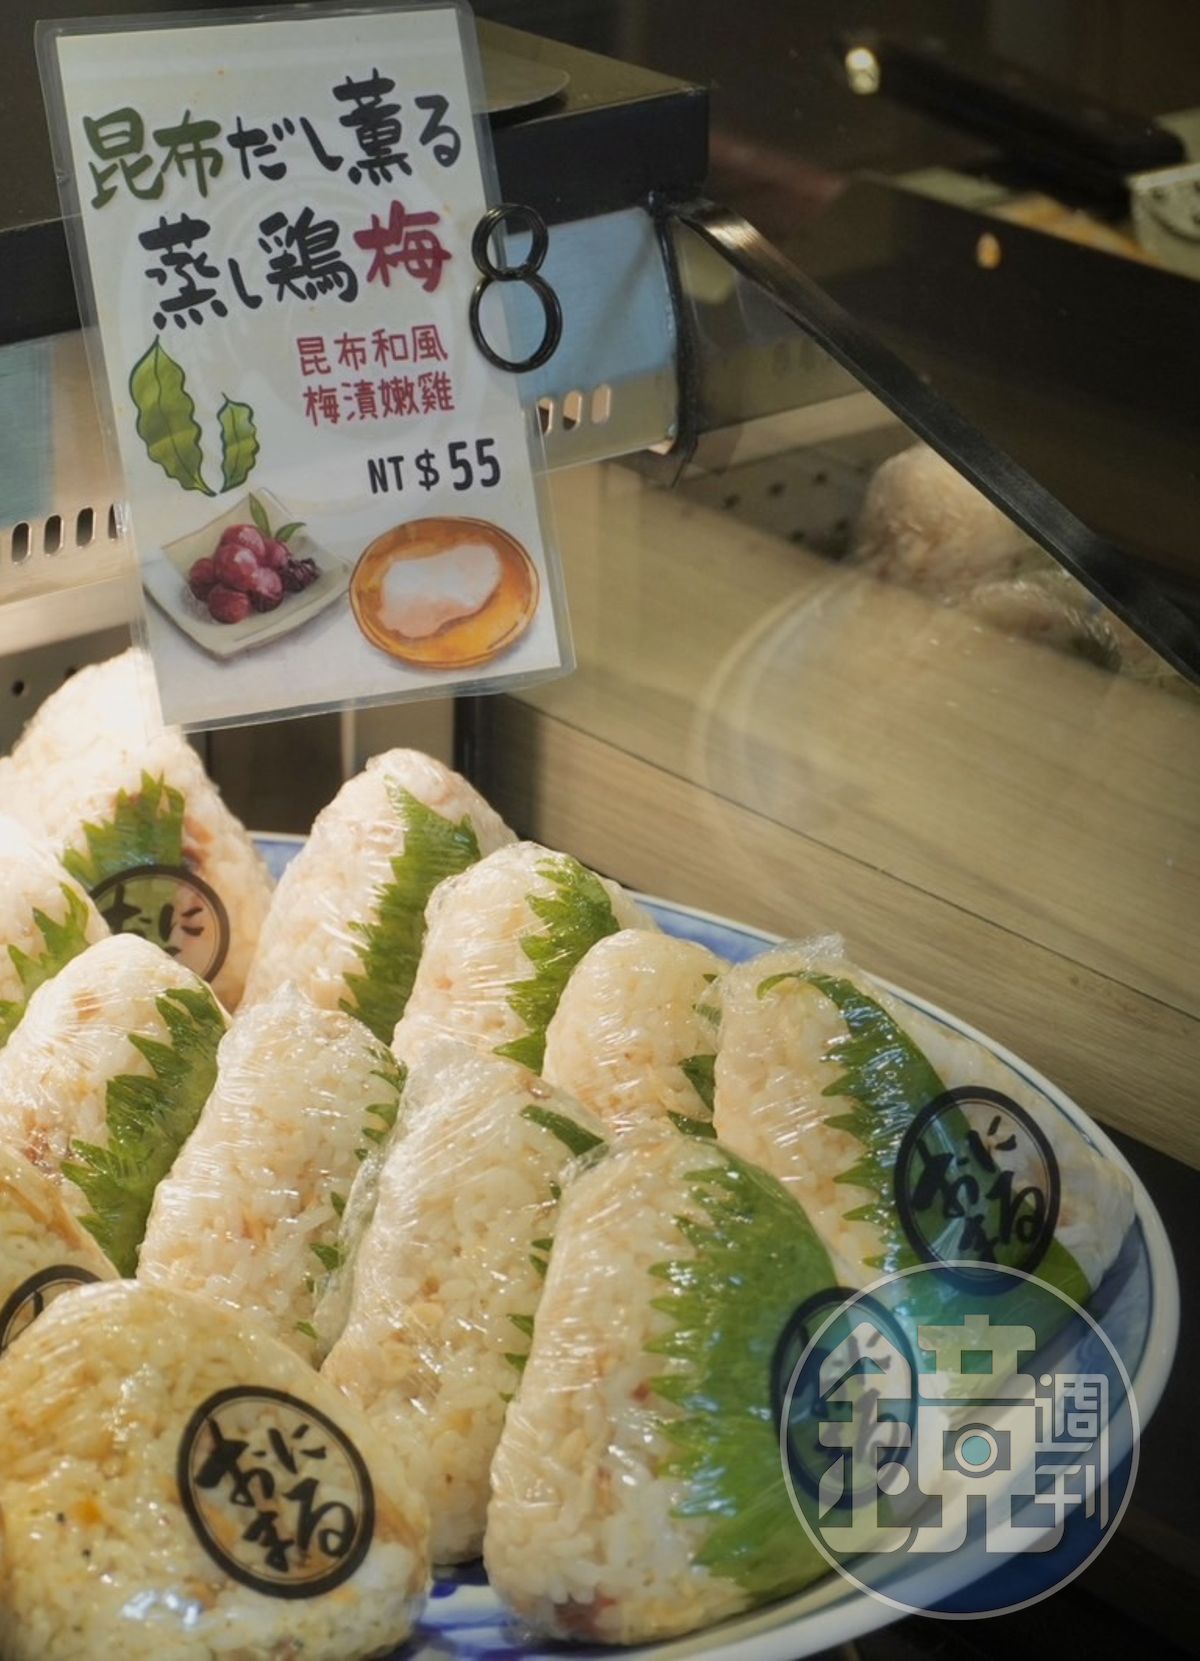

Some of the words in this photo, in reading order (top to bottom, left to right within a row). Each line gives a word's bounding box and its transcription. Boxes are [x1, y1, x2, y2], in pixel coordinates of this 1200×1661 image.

[83, 68, 463, 209] 昆布だし薫る
[138, 200, 452, 331] 蒸し鶏梅
[296, 324, 449, 376] 昆布和風
[302, 371, 455, 427] 梅漬嫩雞
